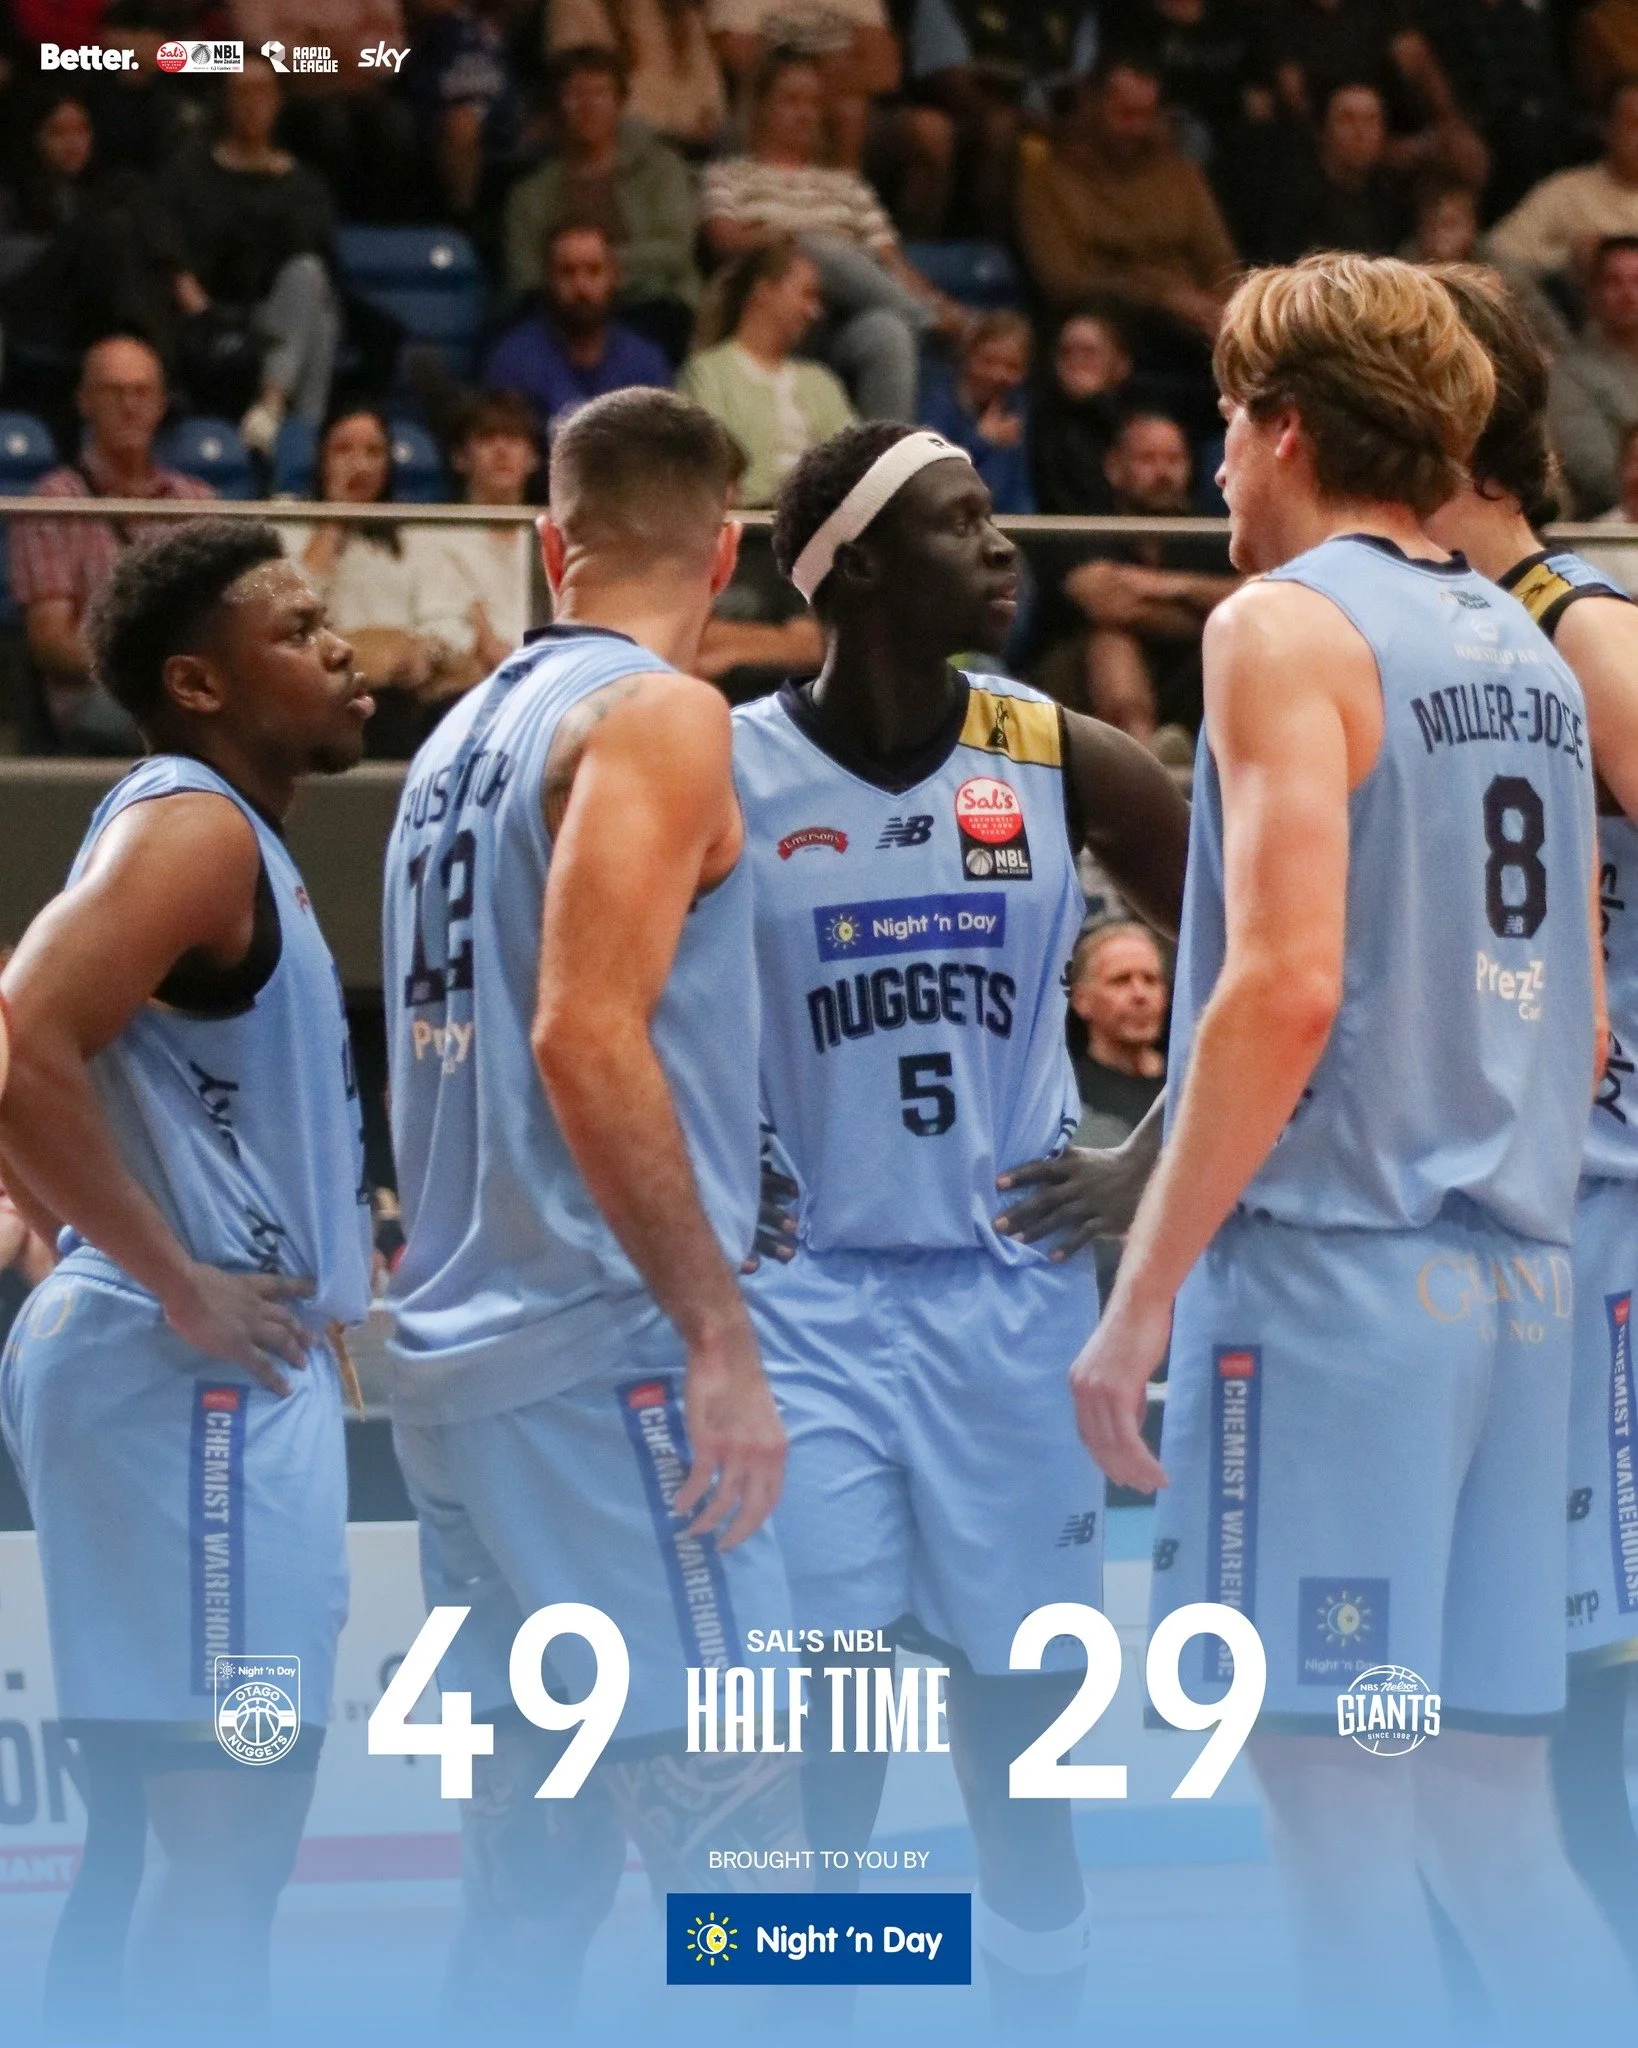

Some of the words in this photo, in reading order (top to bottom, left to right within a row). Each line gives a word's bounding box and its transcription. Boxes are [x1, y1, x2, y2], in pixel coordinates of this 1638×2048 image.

[963, 788, 1013, 810] Sal's
[995, 849, 1029, 868] NBL
[1483, 775, 1547, 939] 8
[872, 915, 928, 940] Night
[958, 912, 996, 934] Day
[806, 962, 1016, 1054] NUGGETS
[899, 1052, 956, 1137] 5
[204, 1410, 231, 1523] CHEMIST
[1220, 1379, 1247, 1500] CHEMIST
